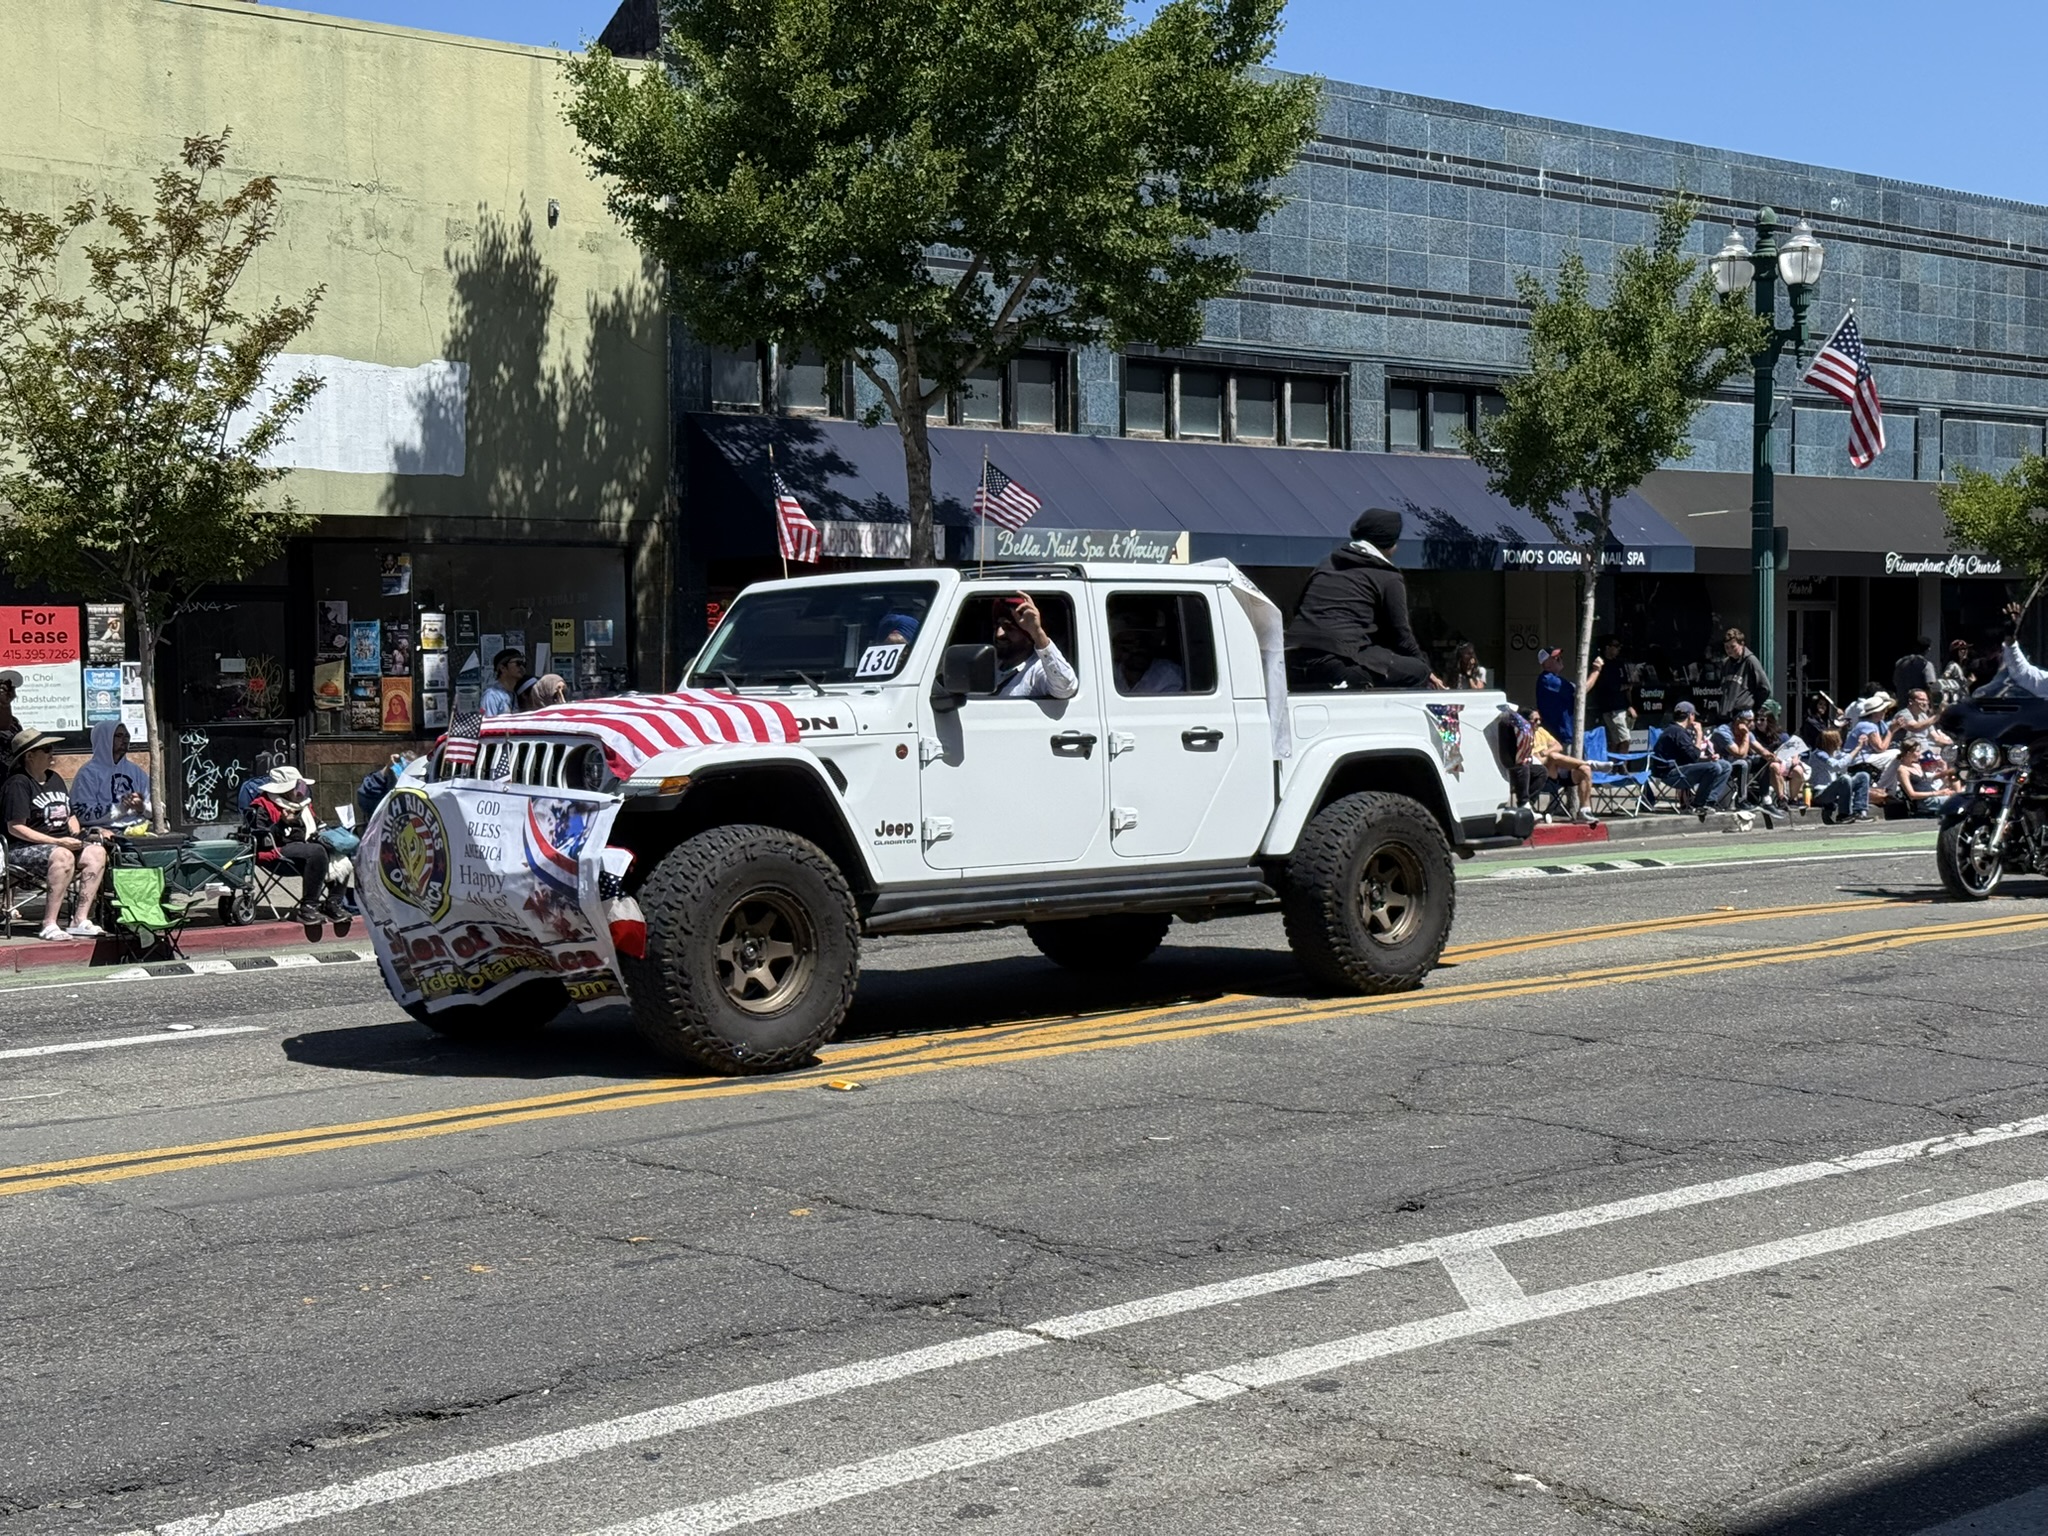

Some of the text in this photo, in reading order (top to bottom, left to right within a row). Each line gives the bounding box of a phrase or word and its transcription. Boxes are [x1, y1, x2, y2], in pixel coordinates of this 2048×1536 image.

[997, 530, 1169, 563] Bella Nail Spa & Waxing
[1503, 549, 1645, 566] TOMO'S ORGA NAIL SPA
[1885, 551, 2002, 578] Triumphant Life Church
[21, 609, 56, 625] For
[554, 622, 571, 630] IMP
[9, 628, 69, 644] Lease
[2, 648, 76, 660] 415.395.7262
[860, 648, 899, 673] 130
[32, 673, 54, 682] Choi
[22, 695, 71, 703] Badstubner
[1640, 688, 1665, 700] Sunday
[1692, 686, 1723, 696] Wednesd
[67, 719, 79, 727] JLL
[476, 800, 500, 816] GOD
[404, 794, 444, 851] RIDERS
[467, 821, 501, 838] BLESS
[875, 820, 914, 838] Jeep
[464, 844, 502, 861] AMERICA
[459, 864, 506, 894] Happy
